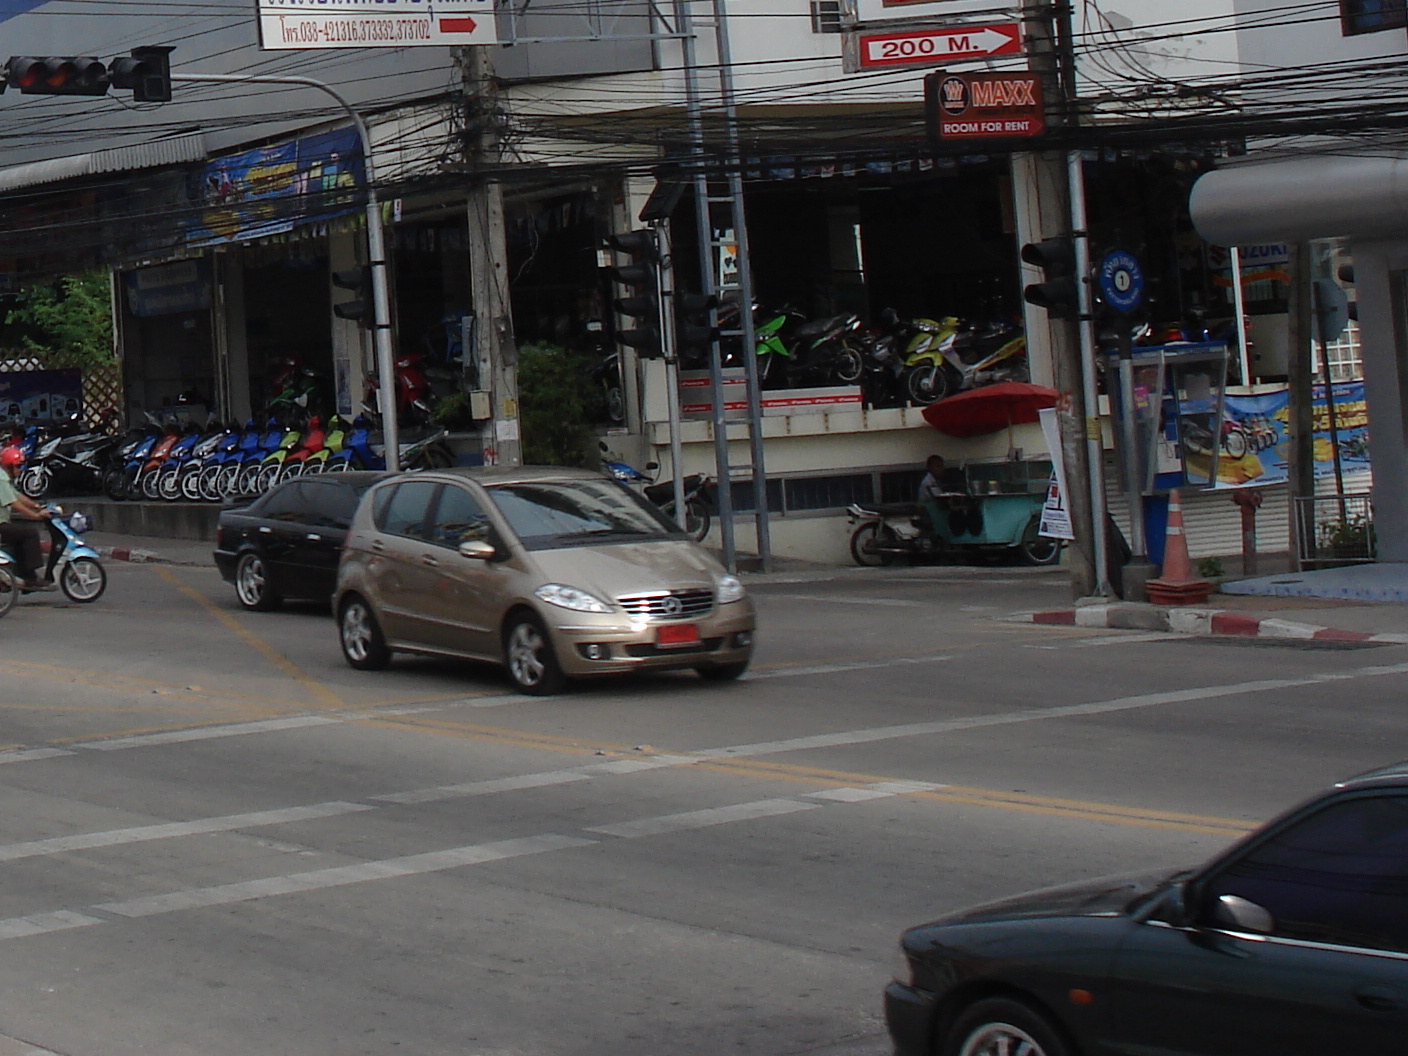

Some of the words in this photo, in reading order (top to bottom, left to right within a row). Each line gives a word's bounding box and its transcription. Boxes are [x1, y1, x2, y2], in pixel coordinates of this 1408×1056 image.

[882, 38, 935, 58] 200
[948, 36, 979, 52] M.
[972, 80, 1036, 107] MAXX
[944, 123, 978, 133] ROOM
[981, 122, 1002, 132] FOR
[1005, 121, 1029, 131] RENT
